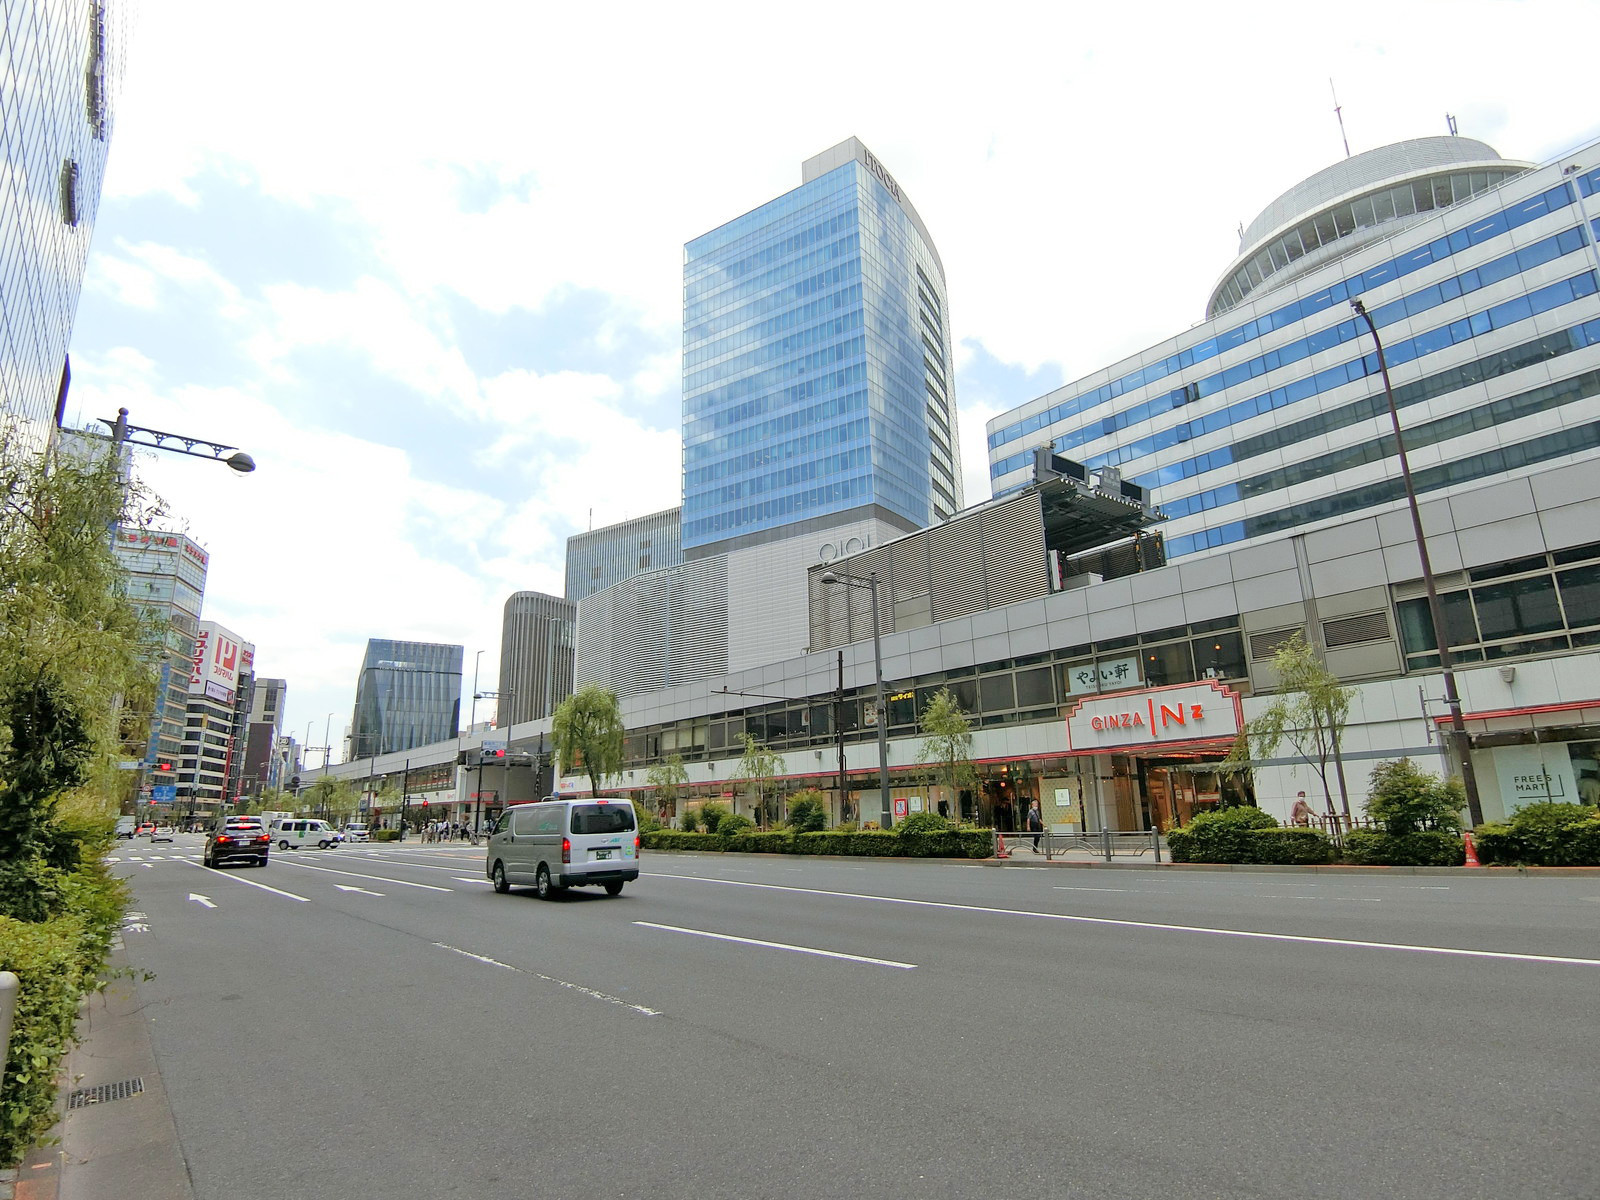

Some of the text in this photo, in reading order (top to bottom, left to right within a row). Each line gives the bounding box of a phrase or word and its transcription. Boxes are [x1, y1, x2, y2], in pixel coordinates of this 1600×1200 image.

[1076, 663, 1129, 685] やよい軒
[1091, 711, 1144, 731] GINZA
[1516, 783, 1545, 792] MART
